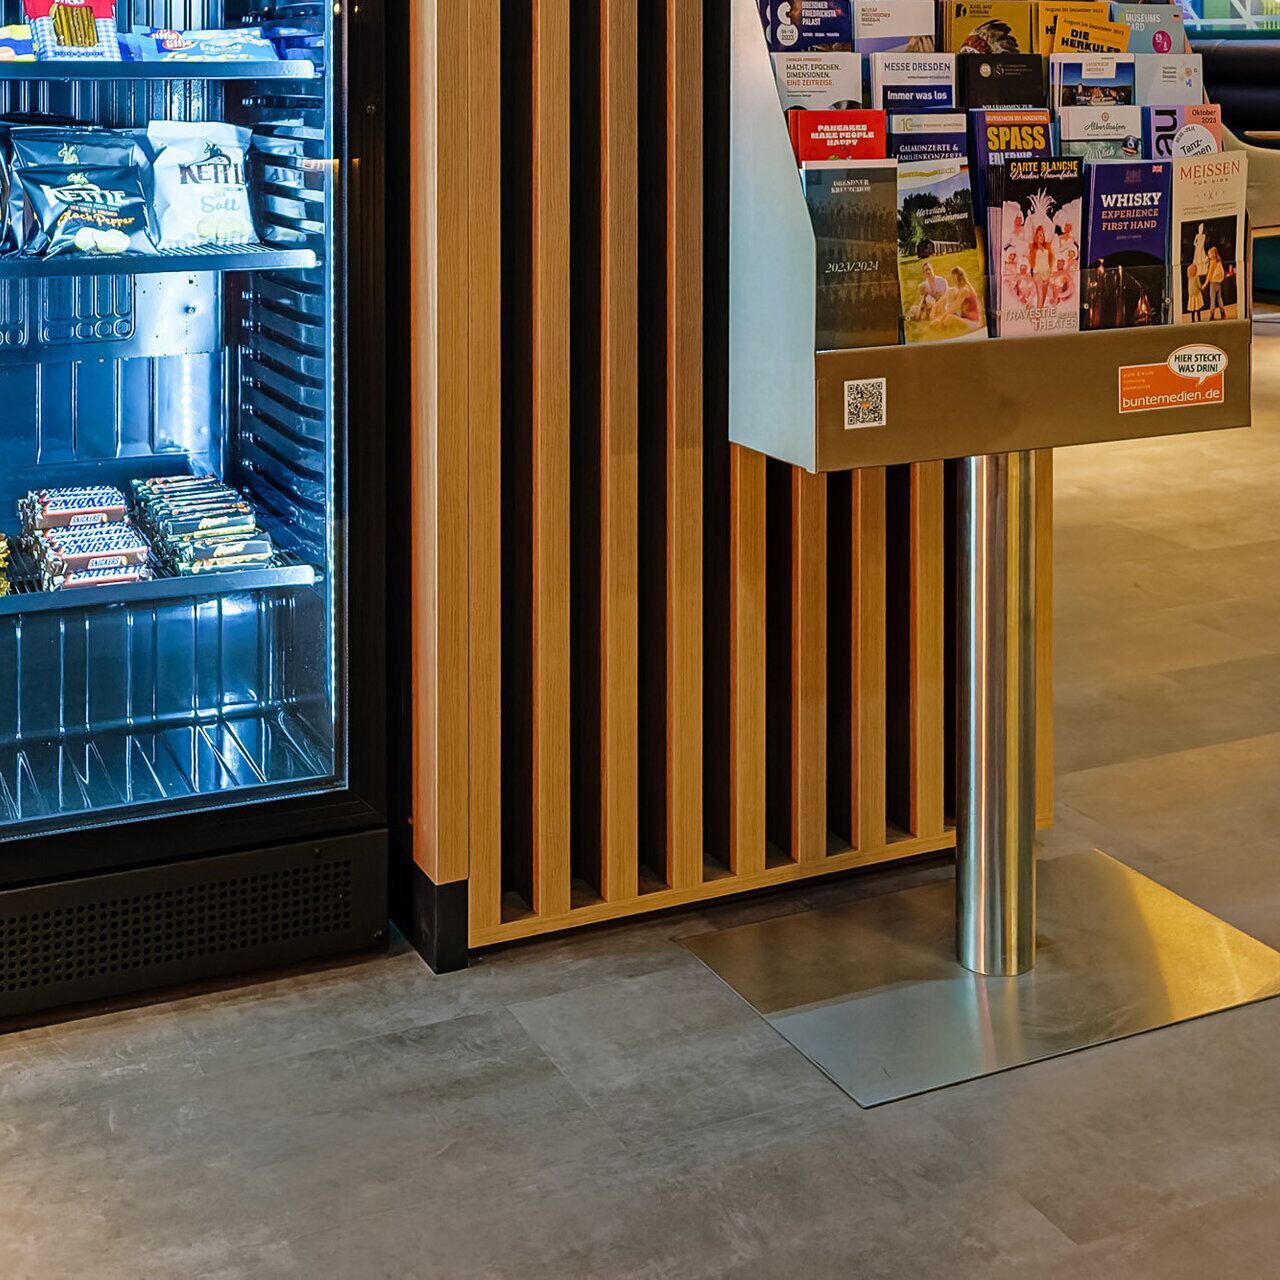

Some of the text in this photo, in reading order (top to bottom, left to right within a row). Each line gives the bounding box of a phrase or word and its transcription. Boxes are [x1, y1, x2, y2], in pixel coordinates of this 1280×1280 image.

[1125, 13, 1161, 23] MUSEUMS
[1071, 28, 1090, 41] DIE
[884, 62, 951, 71] MESSE DRESDEN
[887, 90, 947, 100] Immer was los
[1191, 109, 1216, 117] Oktober
[817, 124, 868, 132] PANCAKES
[839, 131, 875, 139] PEOPLE
[986, 125, 1047, 151] SPASS
[899, 143, 960, 152] GALAKONZERTE &
[1180, 139, 1203, 156] Tanz-
[1010, 160, 1079, 172] CARTE BLANCHE
[1180, 160, 1240, 180] MEISSEN
[1100, 192, 1162, 208] WHISKY
[1101, 208, 1159, 219] EXPERIENCE
[94, 213, 135, 228] Pepper
[1102, 220, 1157, 231] FIRST HAND
[825, 261, 880, 274] 2023/2024
[1004, 306, 1057, 321] TRAVESTIE
[1031, 317, 1078, 331] THEATER
[1174, 353, 1222, 363] HIER STECKT
[1178, 364, 1218, 374] WAS DRIN!
[1122, 388, 1220, 408] buntemedien.de
[72, 514, 101, 523] SNICKERS
[90, 557, 120, 568] SNICKERS
